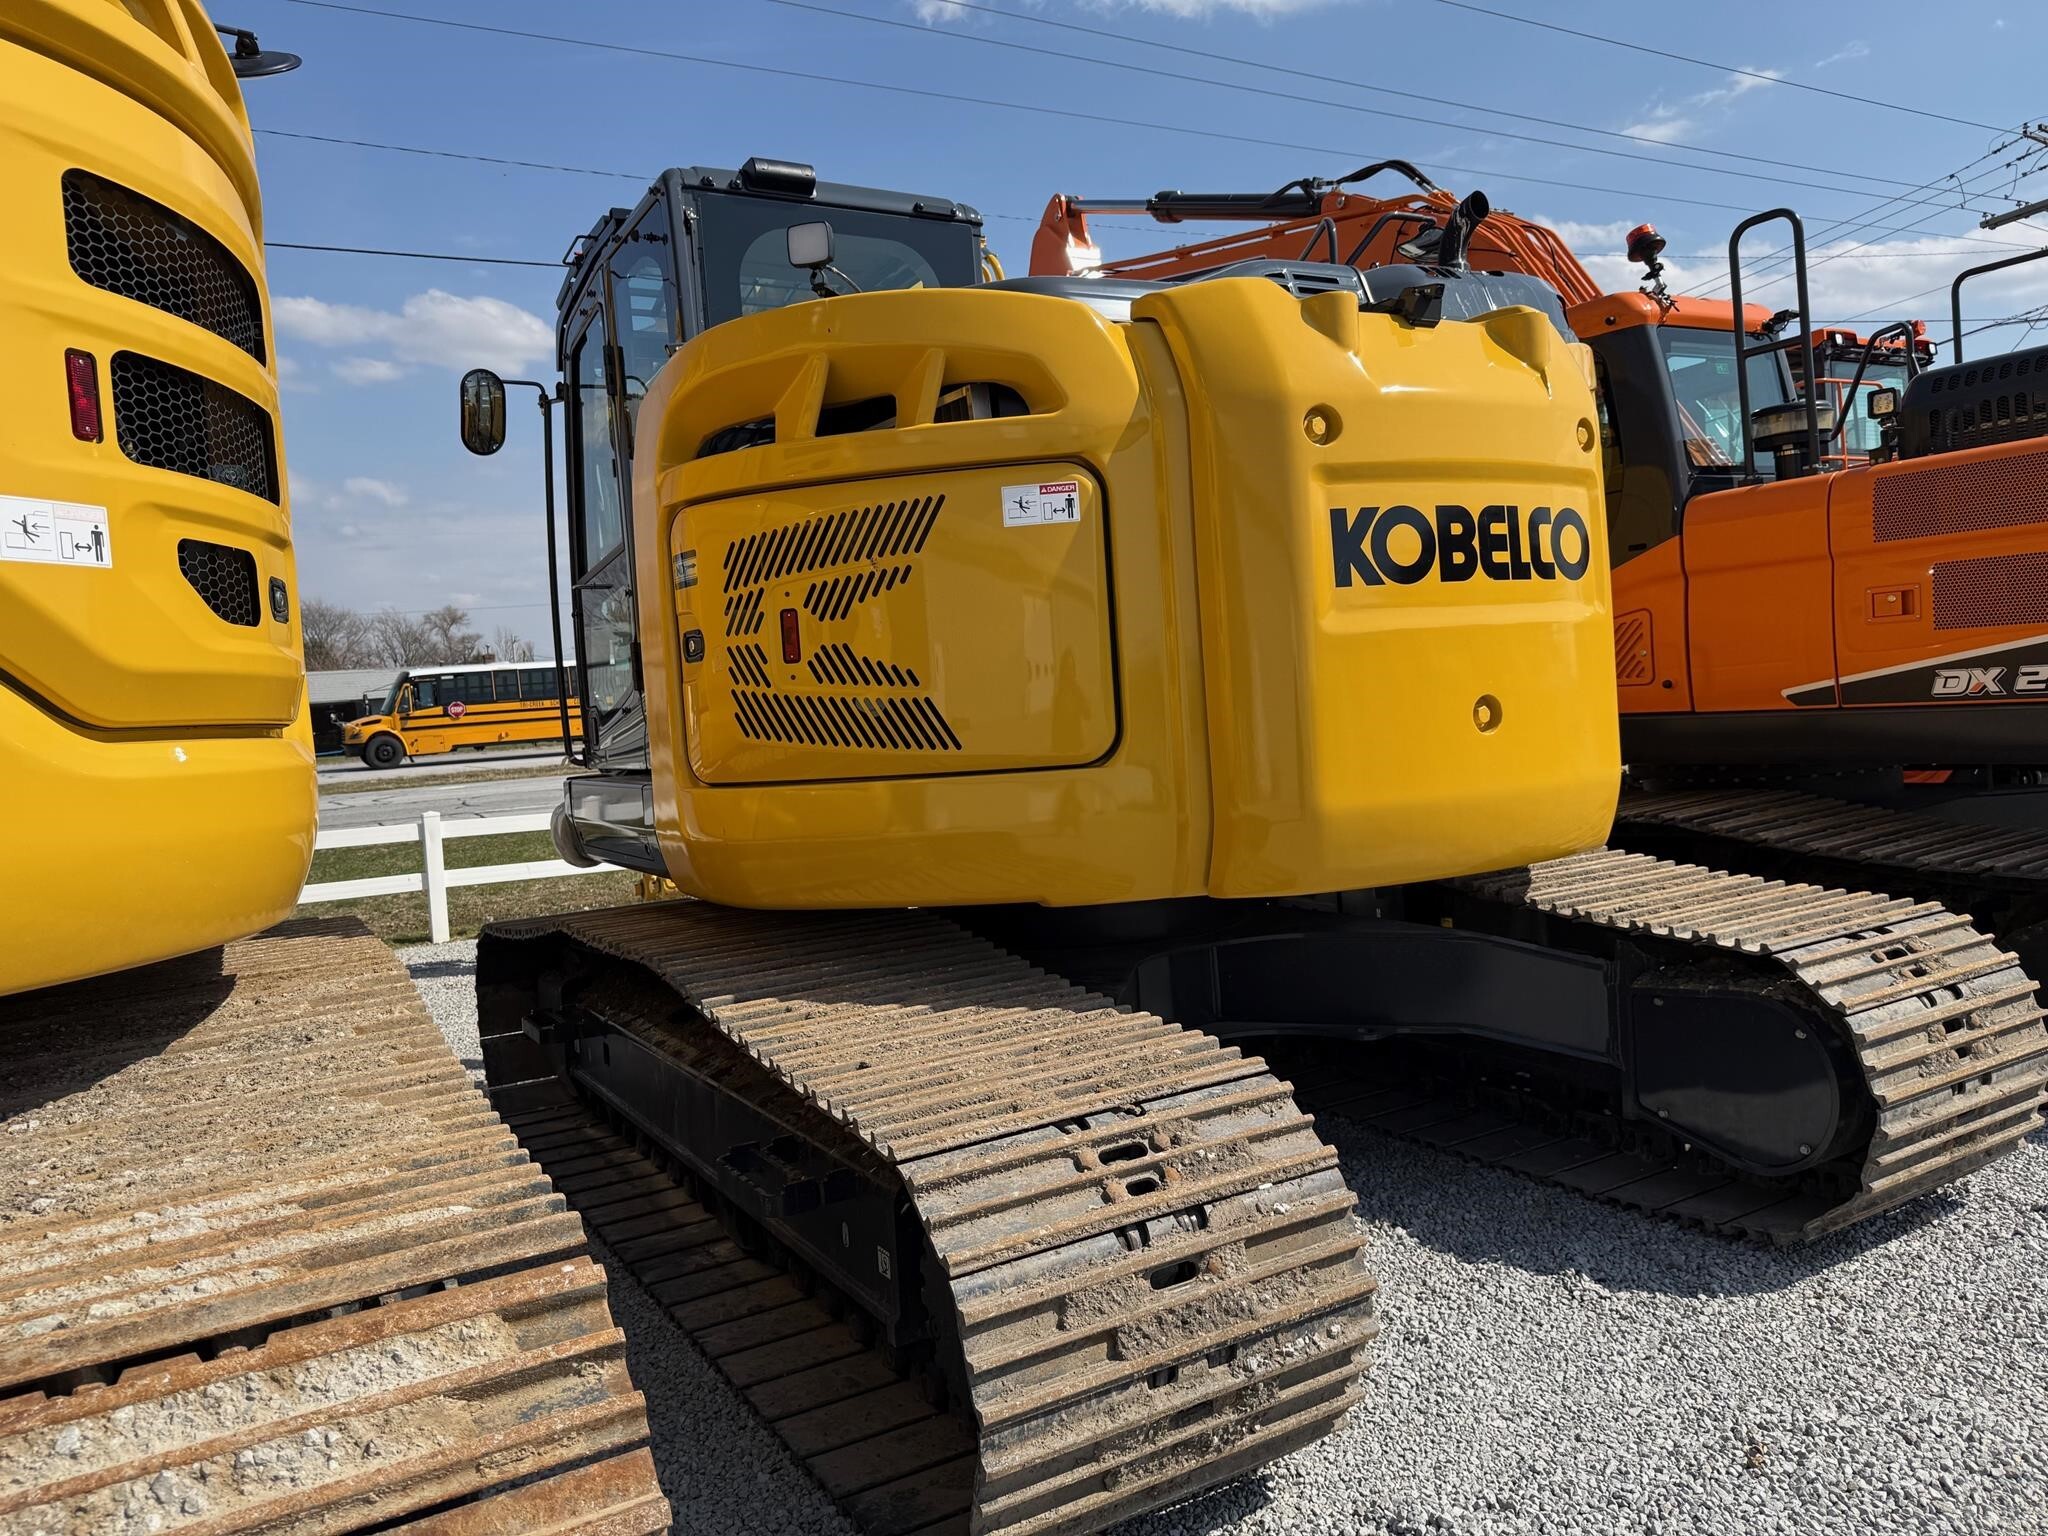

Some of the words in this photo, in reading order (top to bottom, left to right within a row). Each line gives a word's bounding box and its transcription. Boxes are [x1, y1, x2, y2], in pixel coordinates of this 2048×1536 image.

[1329, 505, 1590, 588] KOBELCO
[1931, 666, 2007, 697] DX
[2013, 664, 2048, 695] 2
[450, 706, 464, 714] STOP
